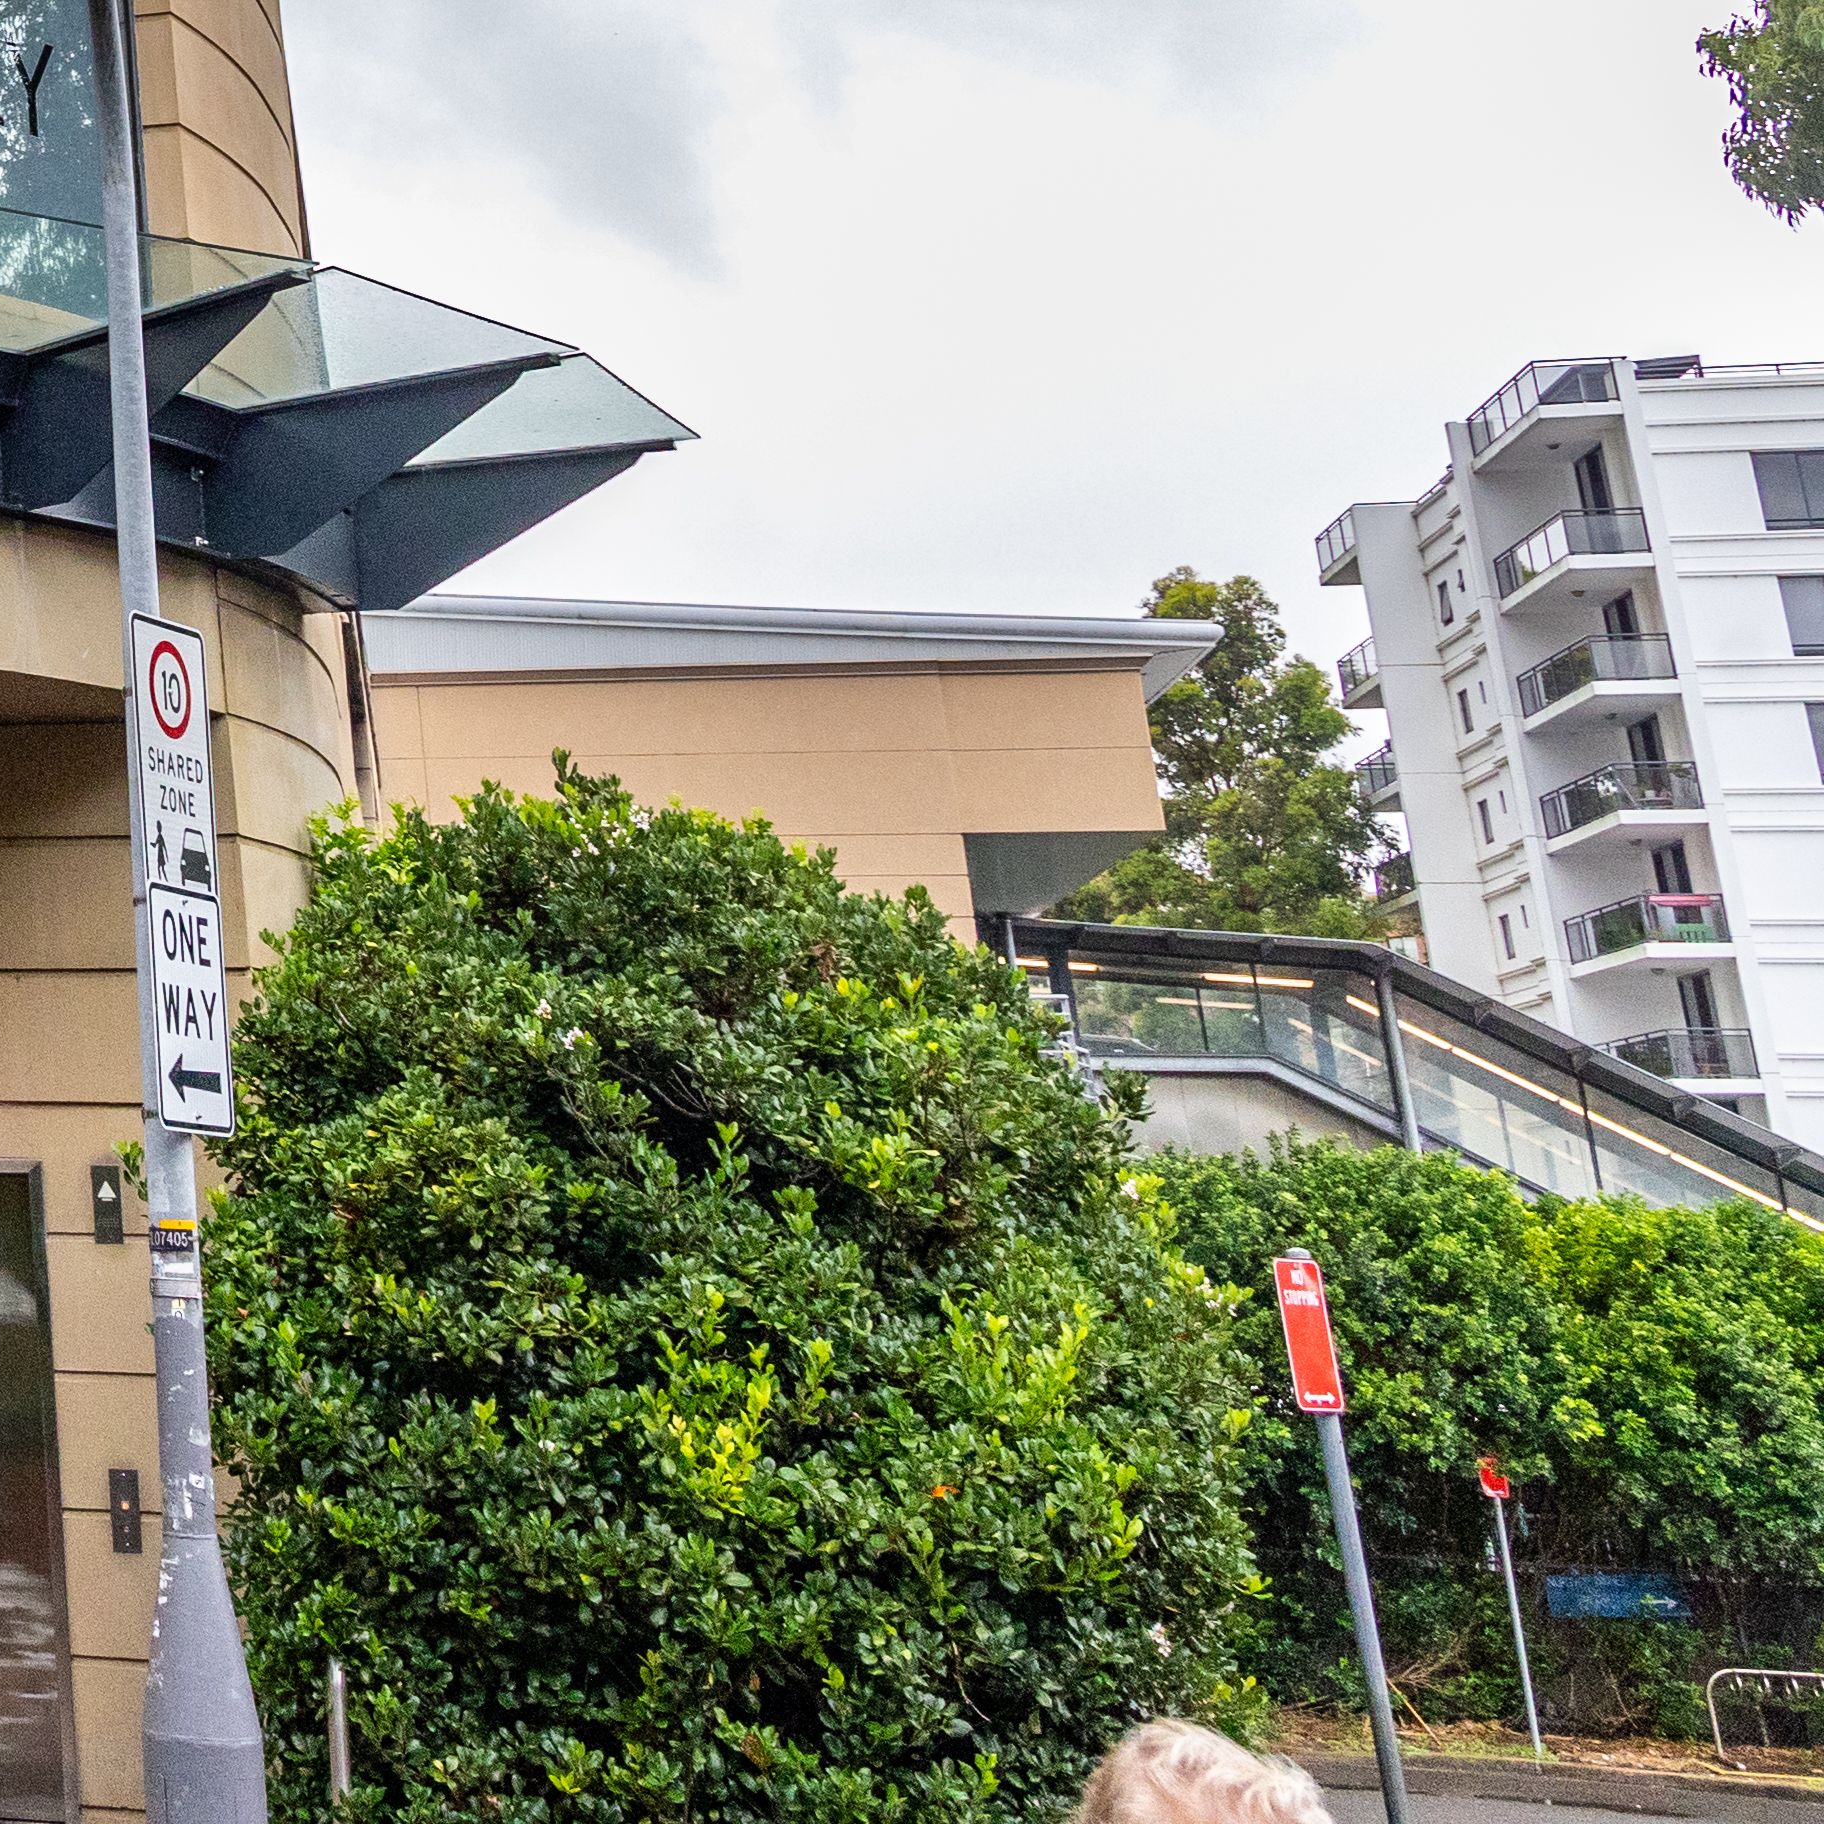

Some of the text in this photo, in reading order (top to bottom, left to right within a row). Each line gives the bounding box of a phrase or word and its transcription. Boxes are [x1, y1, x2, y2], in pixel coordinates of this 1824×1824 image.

[161, 670, 181, 714] 10
[148, 746, 204, 784] SHARED
[160, 784, 196, 817] ZONE
[162, 908, 211, 968] ONE
[162, 981, 216, 1041] WAY
[1291, 1270, 1304, 1285] NO
[1284, 1290, 1319, 1306] STOPPING
